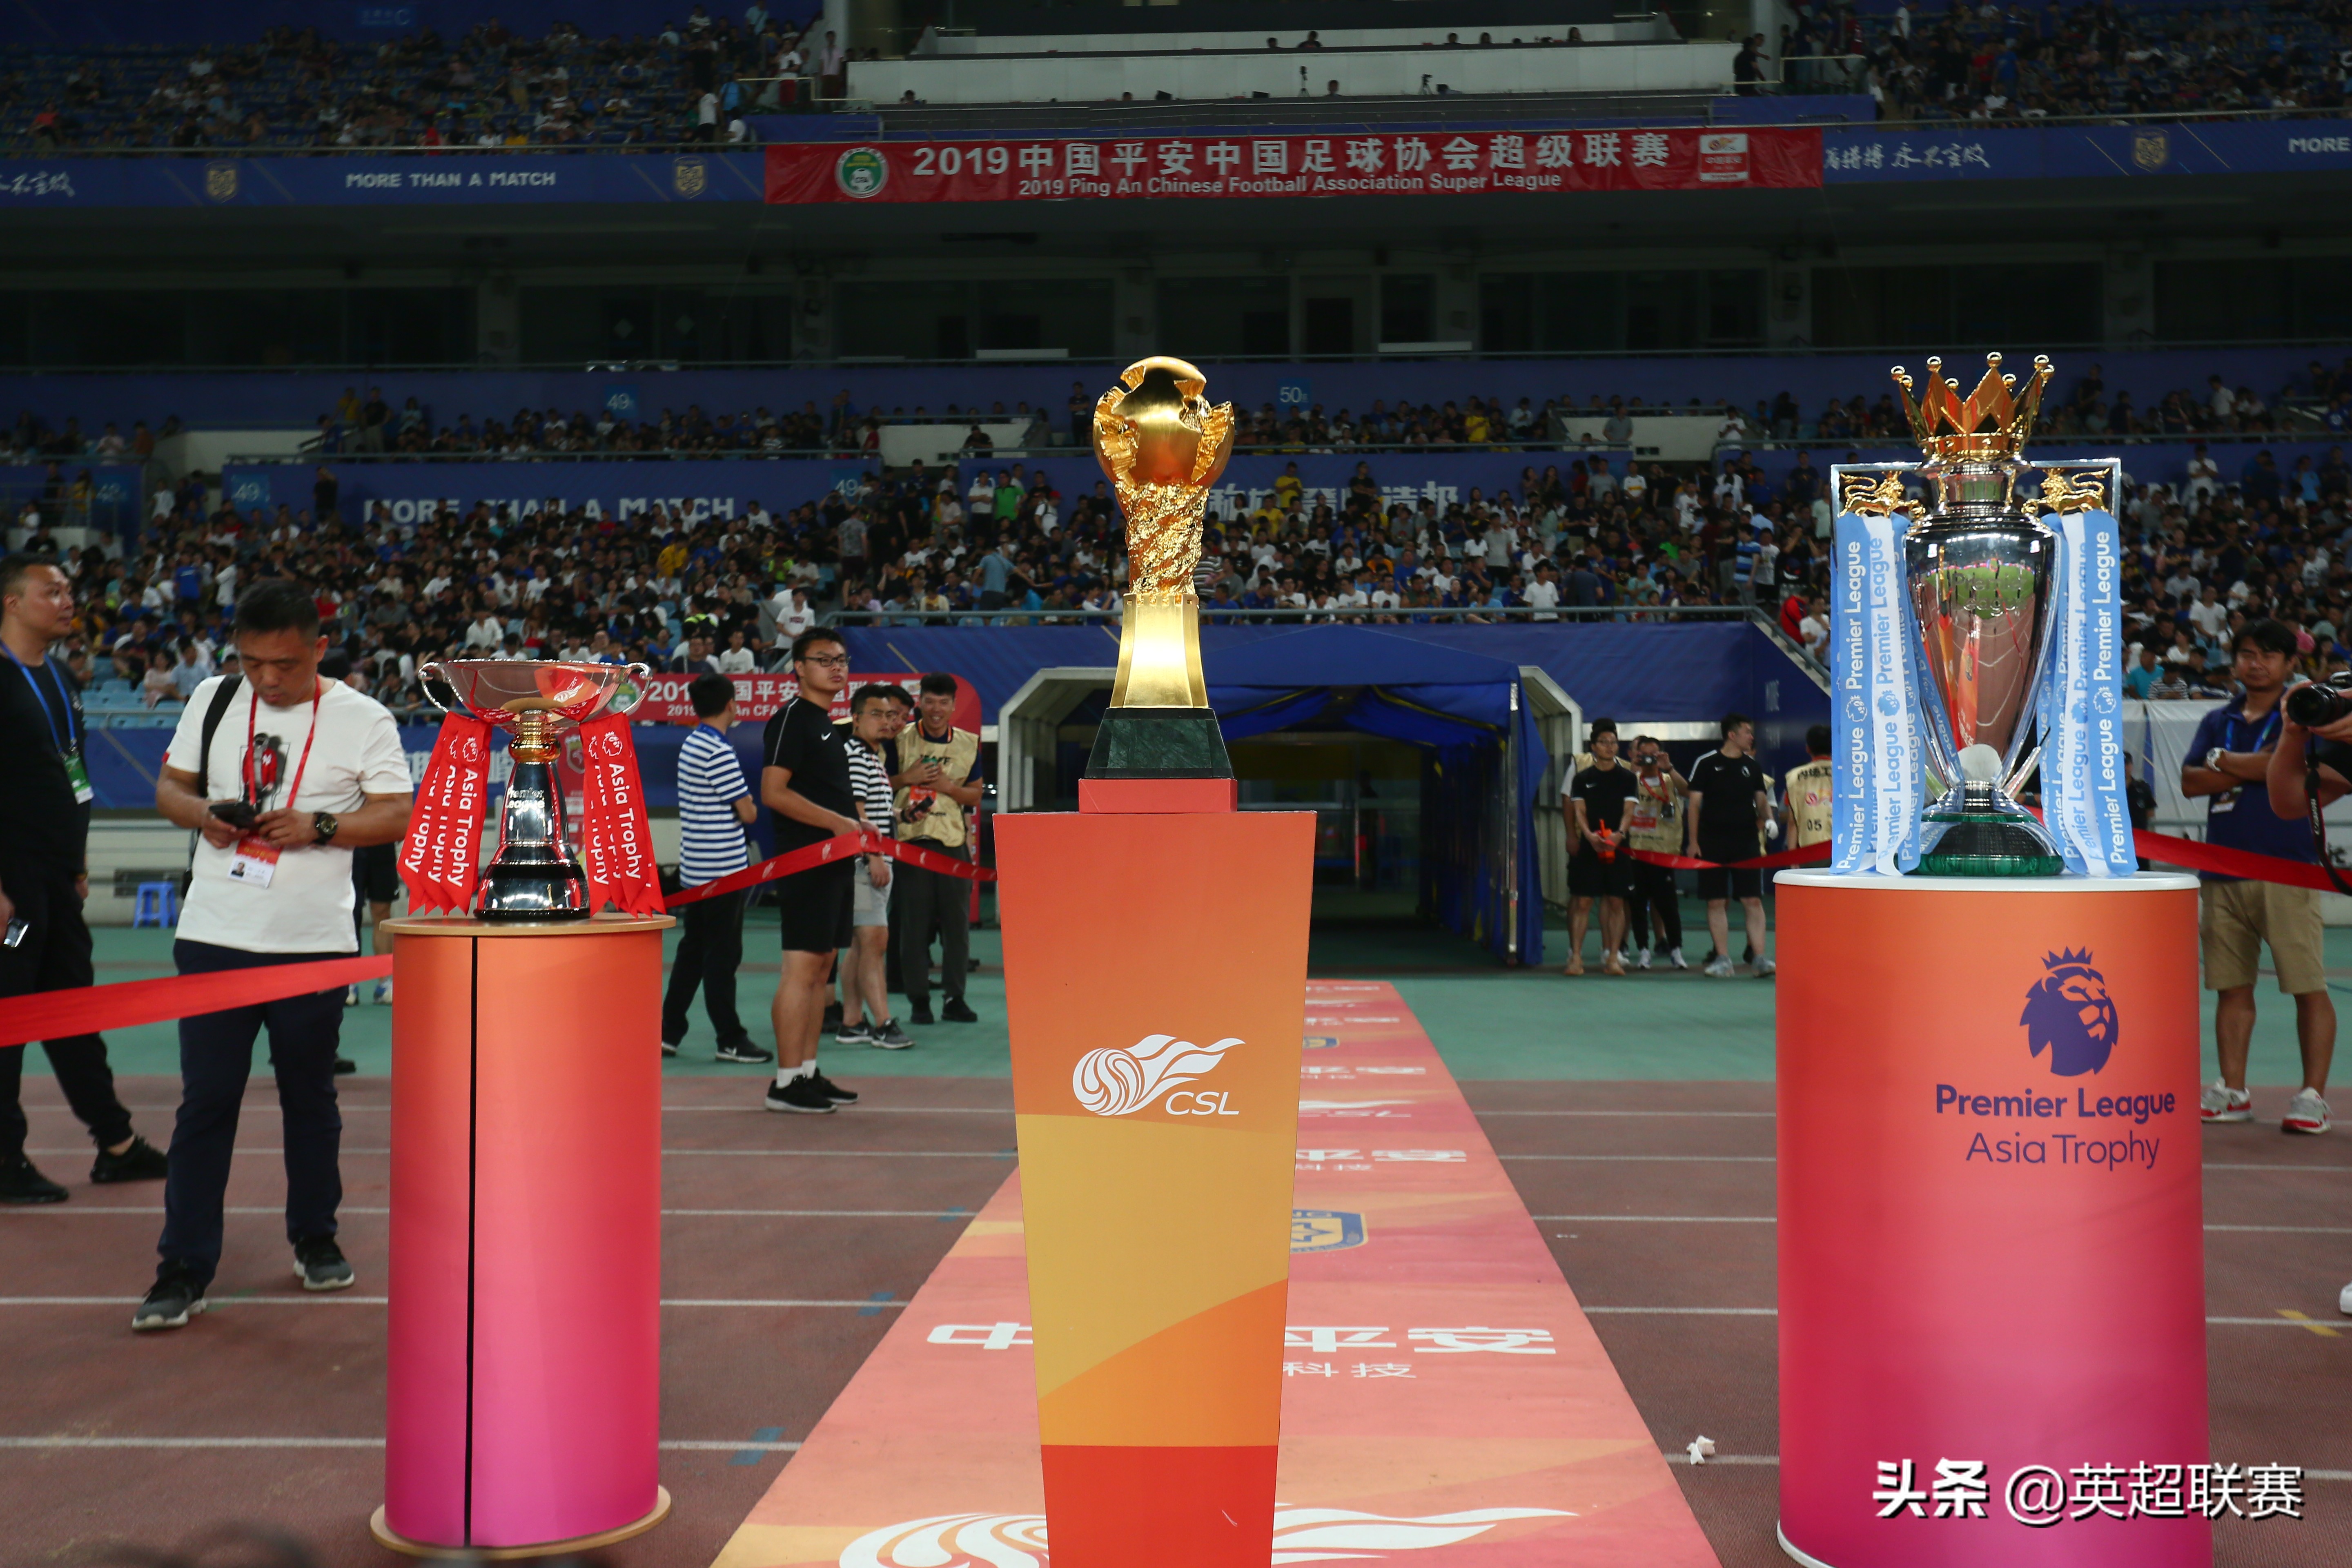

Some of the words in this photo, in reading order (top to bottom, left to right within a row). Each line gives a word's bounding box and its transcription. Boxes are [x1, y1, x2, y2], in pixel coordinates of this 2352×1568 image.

[345, 172, 402, 188] MORE
[409, 172, 462, 187] THAN
[468, 172, 483, 187] A
[489, 172, 557, 187] MATCH
[2288, 137, 2351, 154] MORE
[1020, 178, 1065, 196] 2019
[1069, 178, 1111, 197] Ping
[1116, 177, 1142, 194] An
[1147, 176, 1224, 194] Chinese
[1228, 176, 1307, 193] Football
[1312, 174, 1425, 191] Association
[1429, 171, 1488, 192] Super
[1492, 170, 1562, 190] League
[1844, 541, 1866, 614] League
[1870, 537, 1890, 606] League
[2092, 532, 2116, 604] League
[1845, 618, 1863, 690] Premier
[1873, 615, 1894, 685] Premier
[2093, 608, 2112, 681] Premier
[459, 768, 479, 811] Asia
[1848, 727, 1869, 800] League
[1883, 722, 1905, 793] League
[2068, 730, 2089, 801] League
[2098, 718, 2120, 791] League
[447, 815, 474, 888] Trophy
[608, 762, 630, 805] Asia
[619, 807, 642, 880] Trophy
[1835, 804, 1865, 869] Premier
[2105, 795, 2128, 864] Premier
[1165, 1091, 1240, 1116] CSL
[1936, 1084, 2068, 1118] Premier
[2078, 1087, 2176, 1125] League
[1966, 1131, 2045, 1163] Asia
[2052, 1129, 2160, 1171] Trophy
